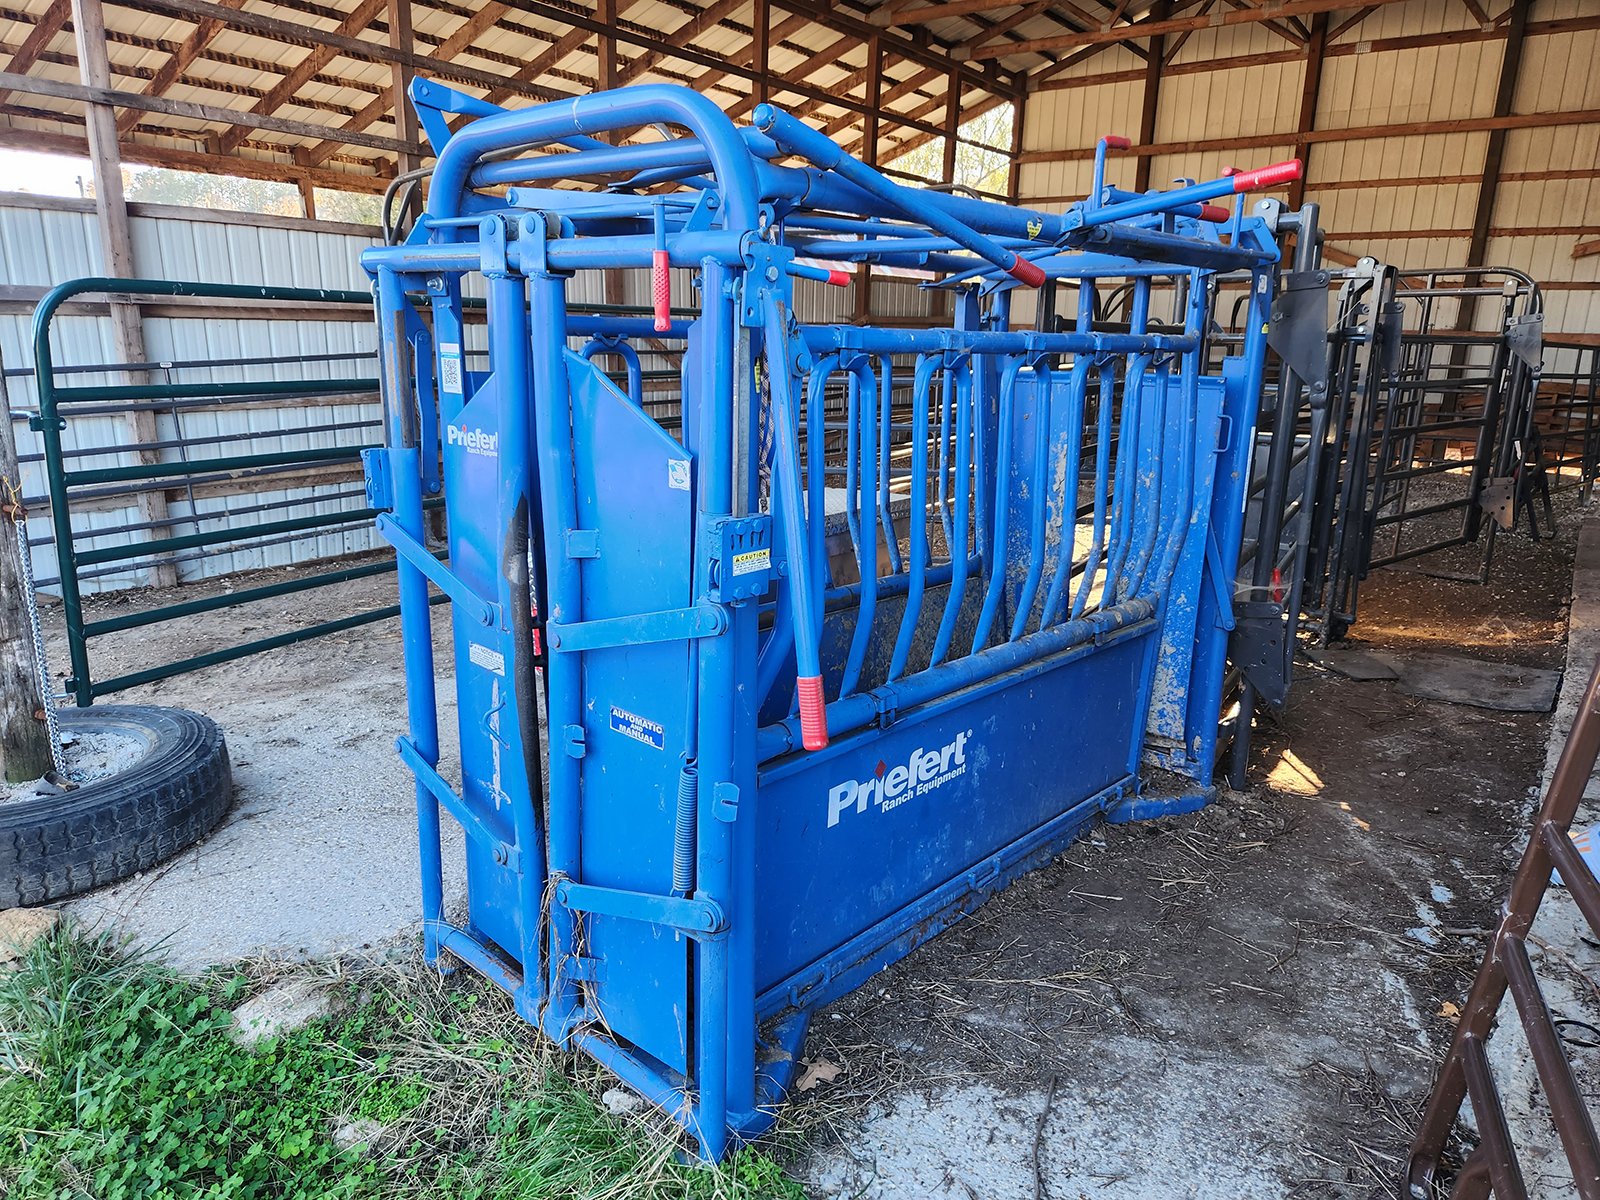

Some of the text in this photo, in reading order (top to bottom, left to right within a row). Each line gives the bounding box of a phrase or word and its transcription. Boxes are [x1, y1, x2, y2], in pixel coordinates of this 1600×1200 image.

[467, 446, 480, 455] Ranch
[740, 551, 767, 561] CAUTION
[612, 708, 663, 734] AUTOMATIC
[630, 723, 644, 733] AND
[618, 723, 656, 745] MANUAL
[881, 763, 967, 814] Ranch Equipment
